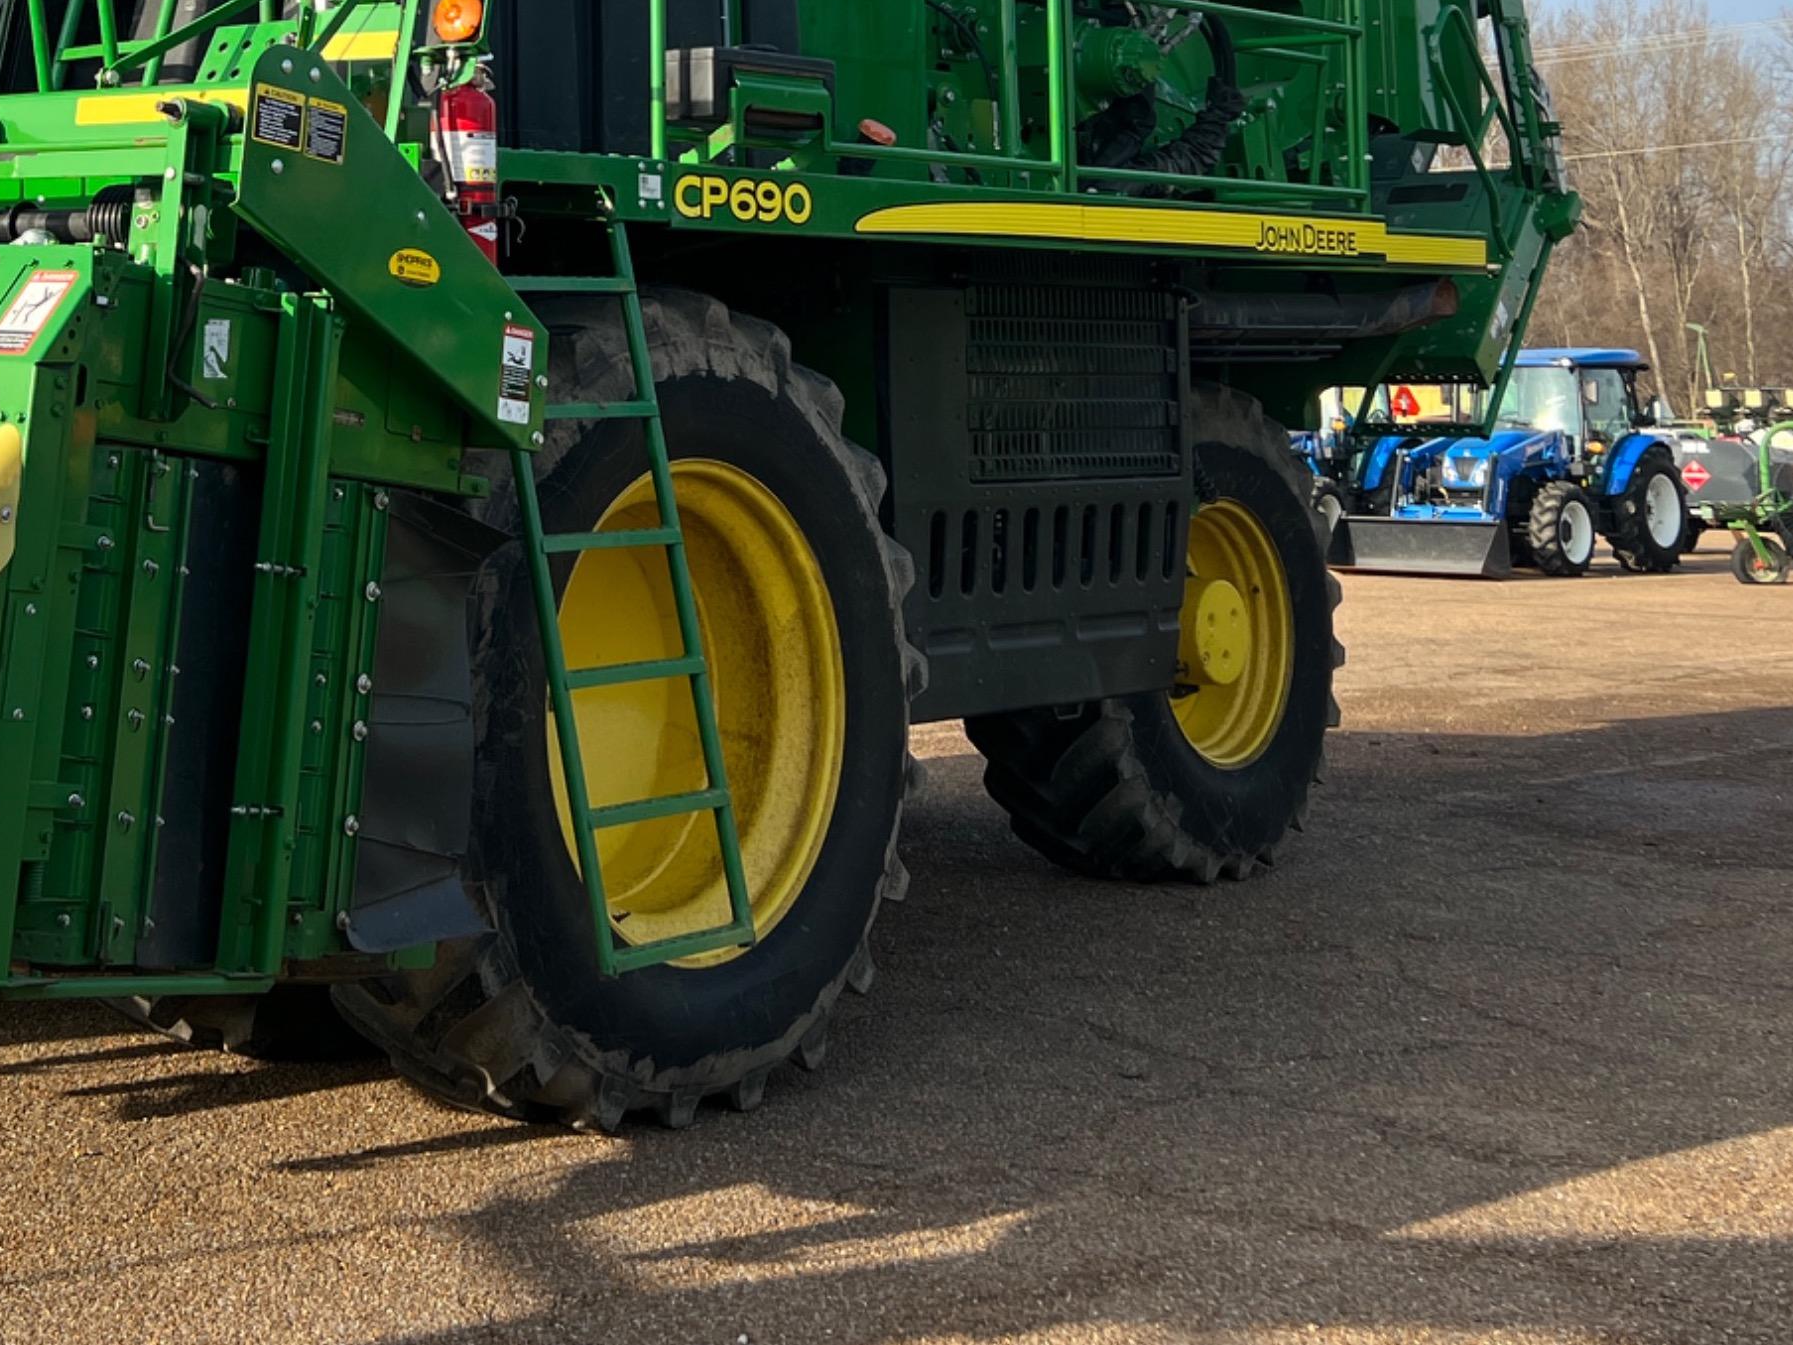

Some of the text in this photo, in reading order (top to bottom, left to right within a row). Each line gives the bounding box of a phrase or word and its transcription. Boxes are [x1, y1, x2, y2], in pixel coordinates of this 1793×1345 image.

[674, 174, 812, 224] CP690
[1256, 220, 1358, 252] JOHN DEERE
